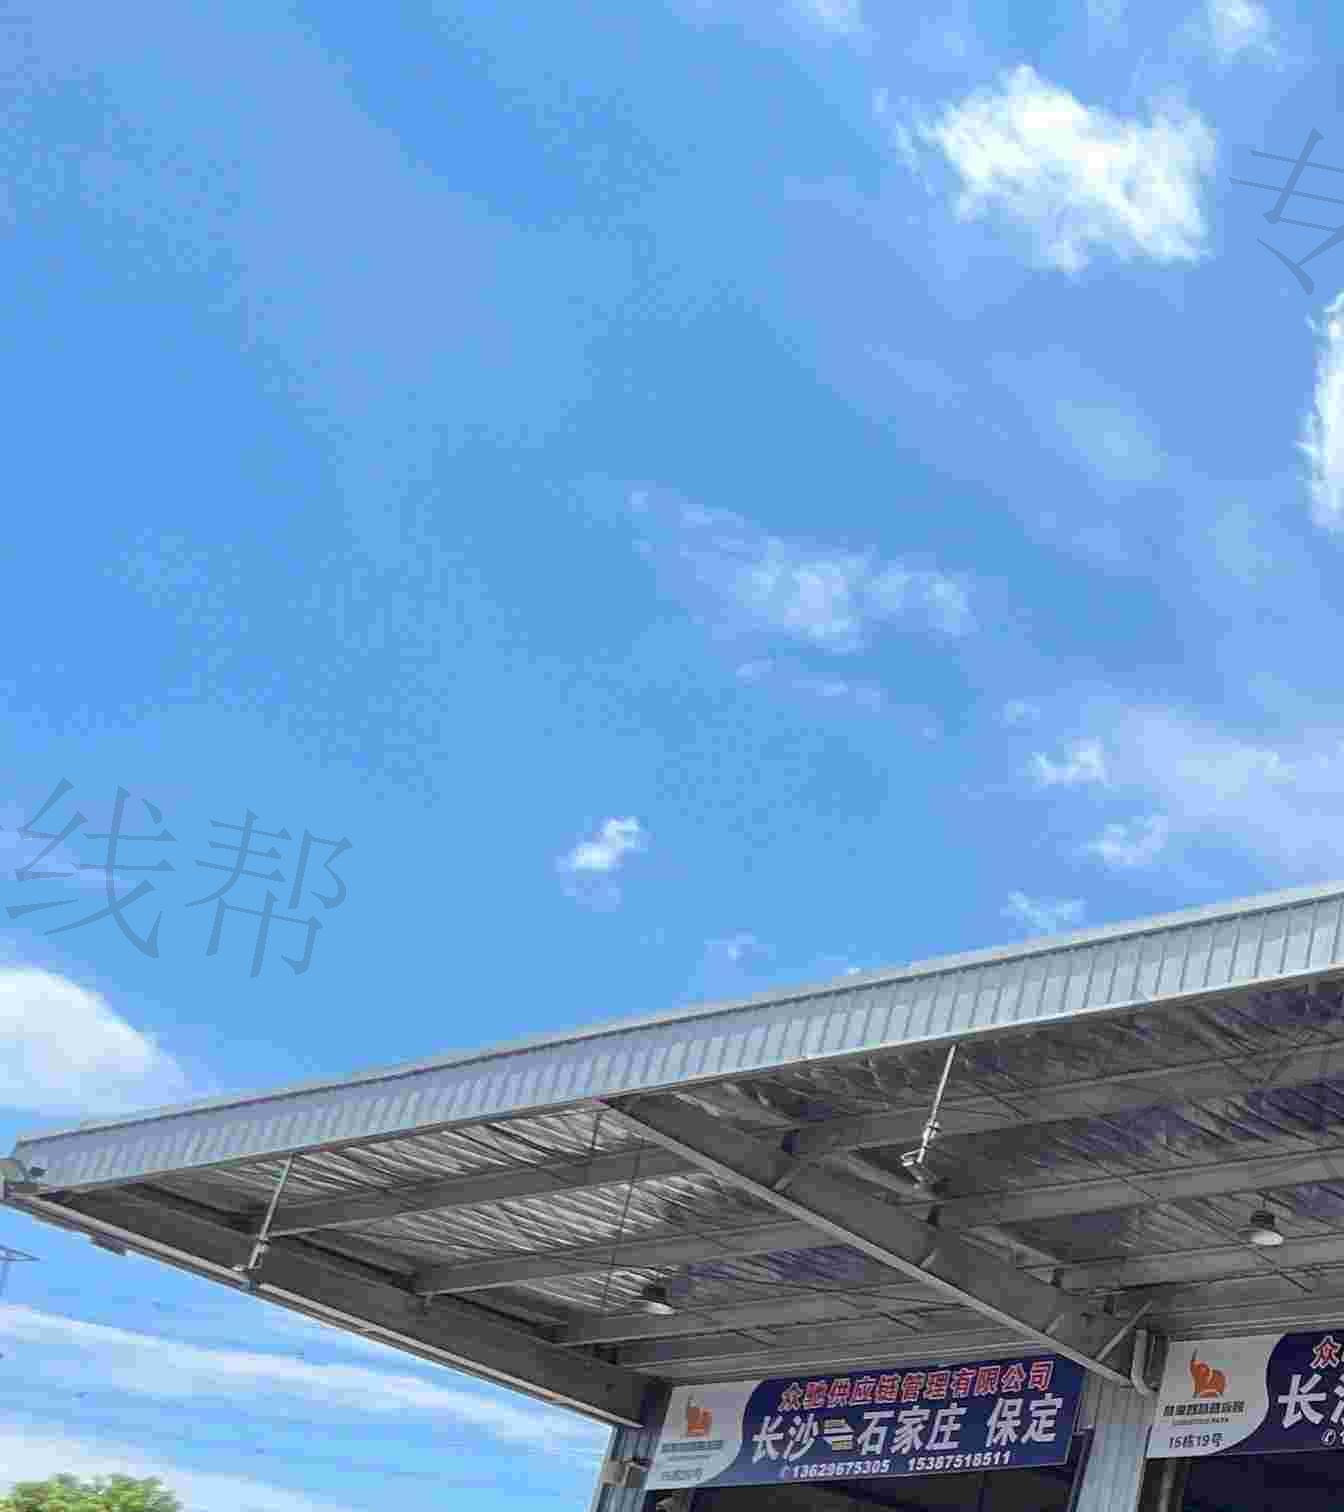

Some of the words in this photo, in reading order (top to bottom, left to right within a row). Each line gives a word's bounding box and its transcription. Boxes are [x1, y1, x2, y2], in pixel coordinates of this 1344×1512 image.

[752, 1413, 818, 1464] 长沙
[856, 1402, 967, 1455] 石家庄
[984, 1393, 1064, 1448] 保定
